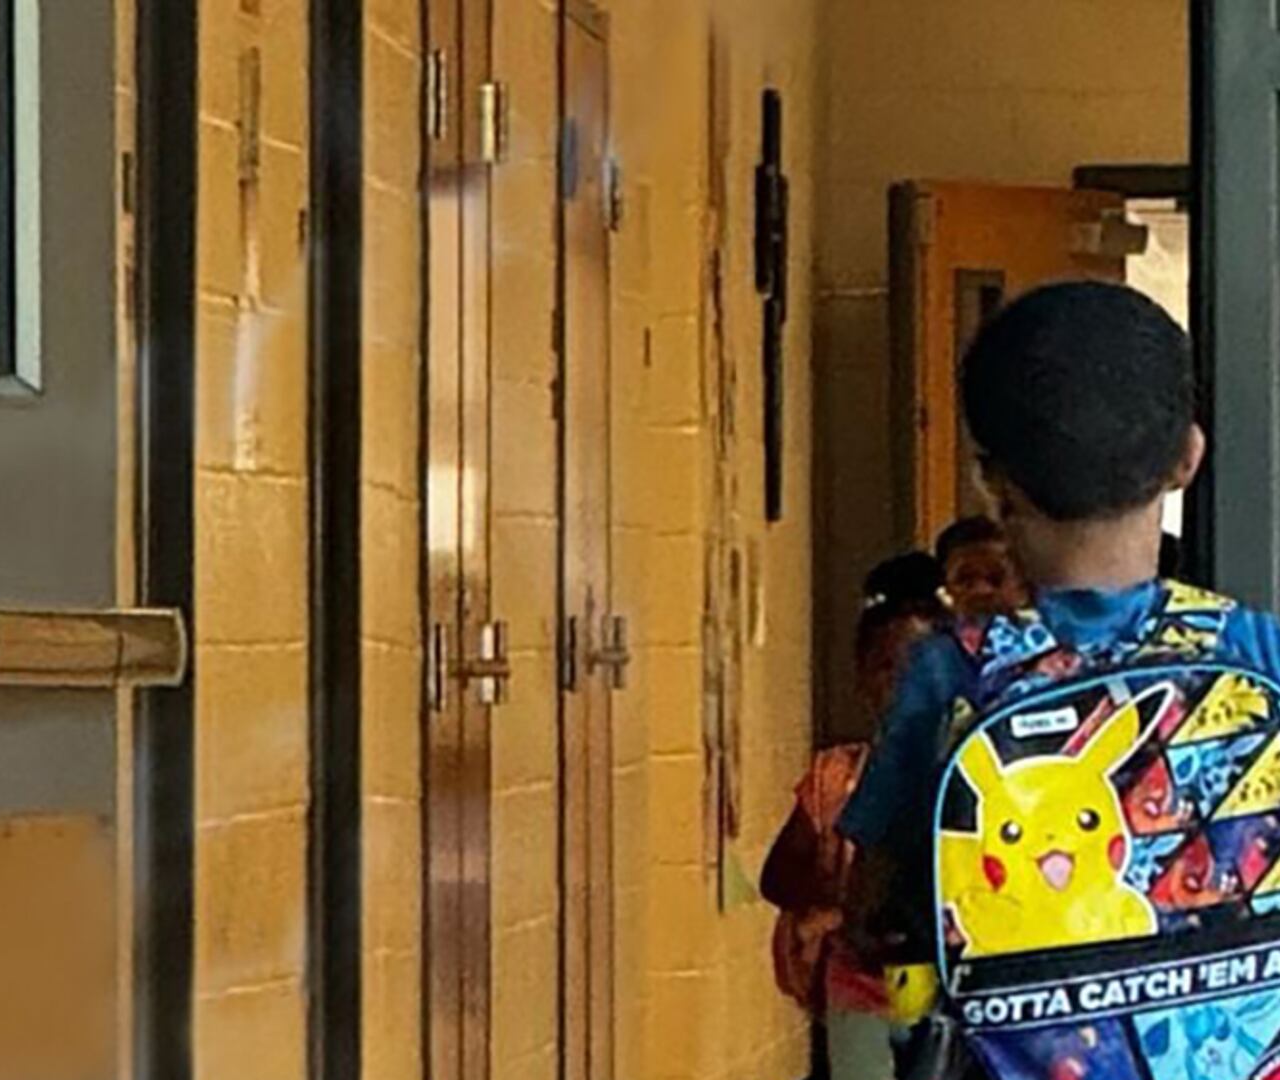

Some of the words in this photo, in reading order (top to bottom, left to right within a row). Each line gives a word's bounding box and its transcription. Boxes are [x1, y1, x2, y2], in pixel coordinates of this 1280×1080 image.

[963, 987, 1070, 1025] GOTTA
[1078, 967, 1192, 1010] CATCH
[1199, 953, 1257, 989] 'EM
